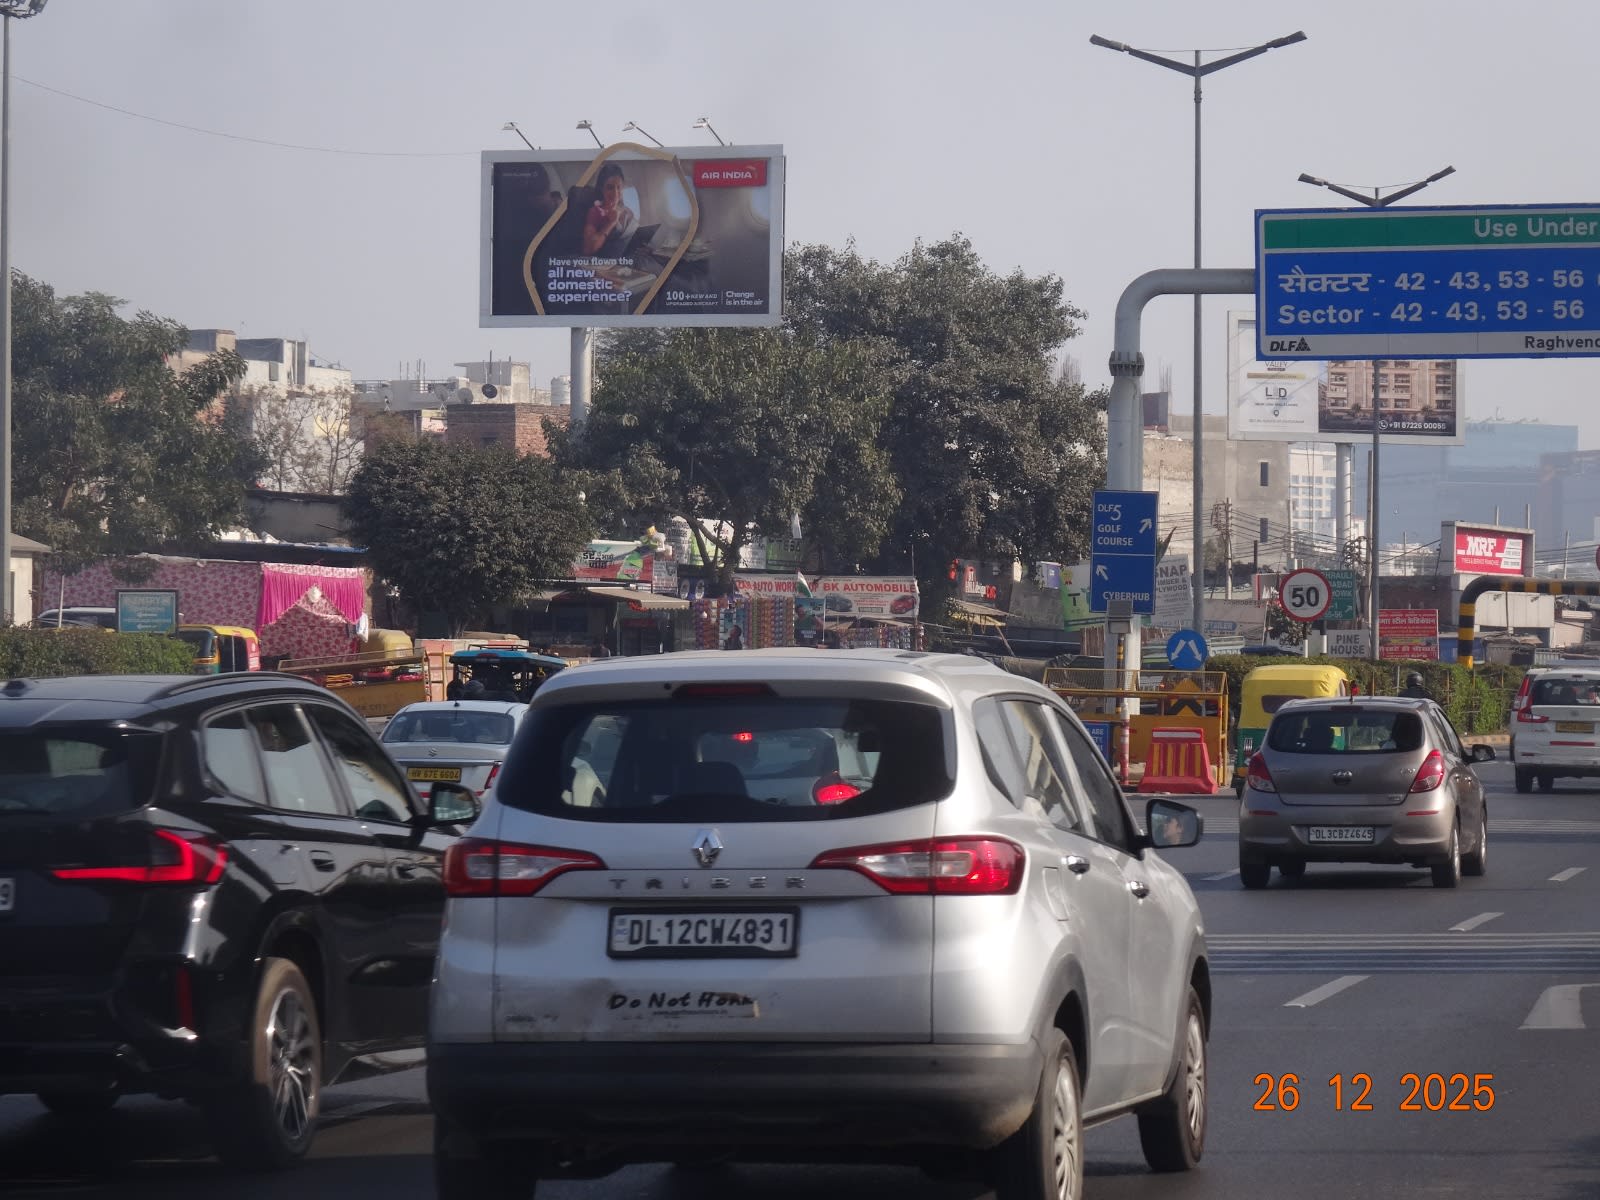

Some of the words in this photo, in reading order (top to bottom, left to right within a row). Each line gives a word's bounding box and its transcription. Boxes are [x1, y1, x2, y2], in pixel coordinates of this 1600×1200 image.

[701, 172, 720, 180] AIR
[722, 171, 752, 180] INDIA
[1474, 218, 1518, 238] Use
[1527, 217, 1598, 237] Under
[549, 257, 571, 266] Have
[572, 259, 588, 267] you
[591, 257, 617, 266] flown
[619, 257, 634, 265] the
[548, 267, 564, 278] all
[566, 269, 596, 278] new
[548, 279, 613, 290] domestic
[1278, 265, 1372, 293] सैक्टर
[1394, 272, 1425, 291] 42
[1498, 270, 1529, 289] 53
[1553, 269, 1584, 288] 56
[548, 290, 633, 304] experience?
[726, 290, 754, 299] Change
[1278, 304, 1364, 325] Sector
[1390, 302, 1423, 322] 42
[1497, 300, 1528, 320] 53
[1553, 299, 1585, 319] 56
[1269, 340, 1297, 352] DLF
[1097, 524, 1122, 533] GOLF
[1097, 536, 1133, 546] COURSE
[1466, 535, 1497, 557] MRF
[752, 581, 773, 592] AUTO
[823, 582, 840, 592] BK
[843, 583, 916, 593] AUTOMOBILE
[1102, 591, 1150, 601] CYBERHUB
[1292, 586, 1320, 608] 50
[1336, 634, 1360, 644] PINE
[1330, 645, 1365, 655] HOUSE
[1315, 828, 1374, 839] DL3CBZ4645
[609, 875, 806, 889] TRIBER
[628, 918, 789, 945] DL12CW4831
[608, 994, 641, 1010] Do
[649, 991, 691, 1008] Not
